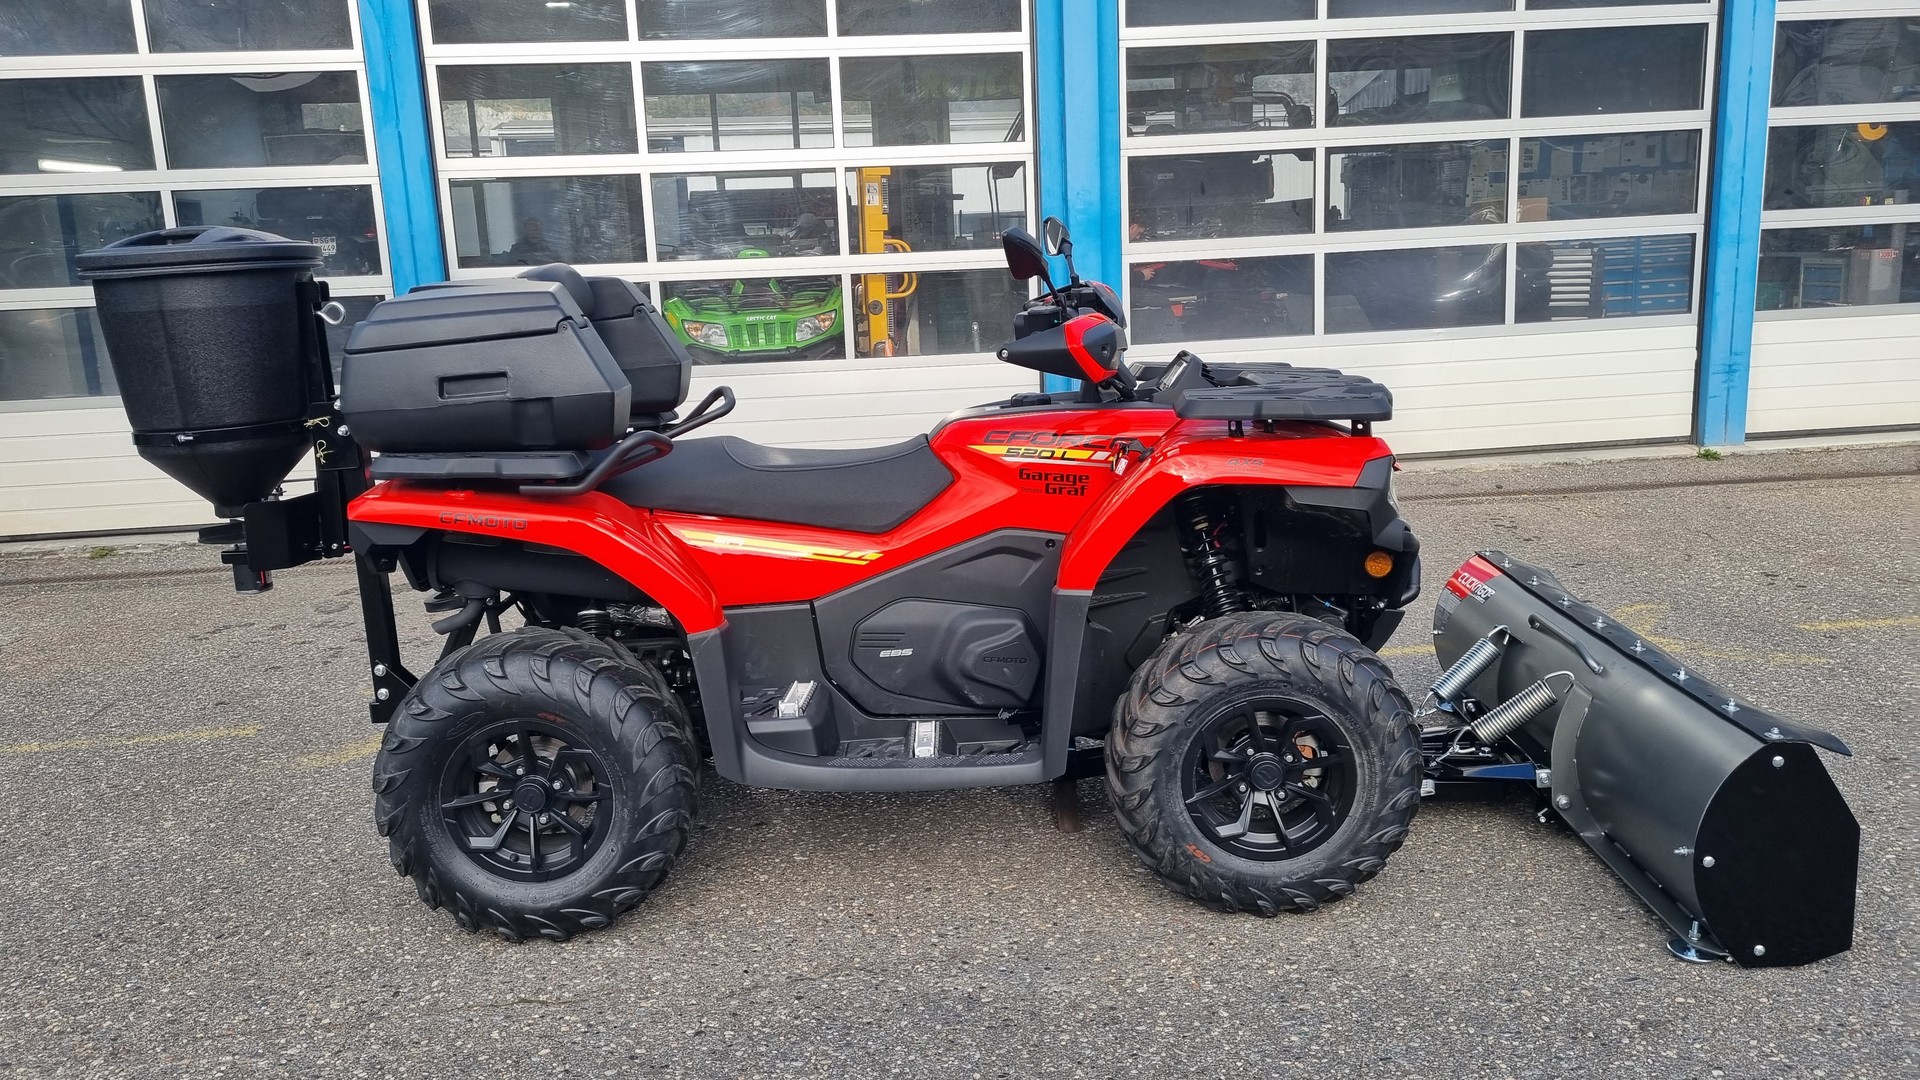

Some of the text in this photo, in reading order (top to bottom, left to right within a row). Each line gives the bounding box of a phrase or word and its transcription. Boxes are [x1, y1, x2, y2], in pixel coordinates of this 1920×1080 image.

[1006, 447, 1076, 461] 520 L
[1018, 468, 1090, 487] Garage
[1045, 484, 1088, 497] Graf
[439, 512, 527, 530] CFMOTO
[879, 648, 914, 658] EBS
[982, 656, 1027, 664] CFMOTO
